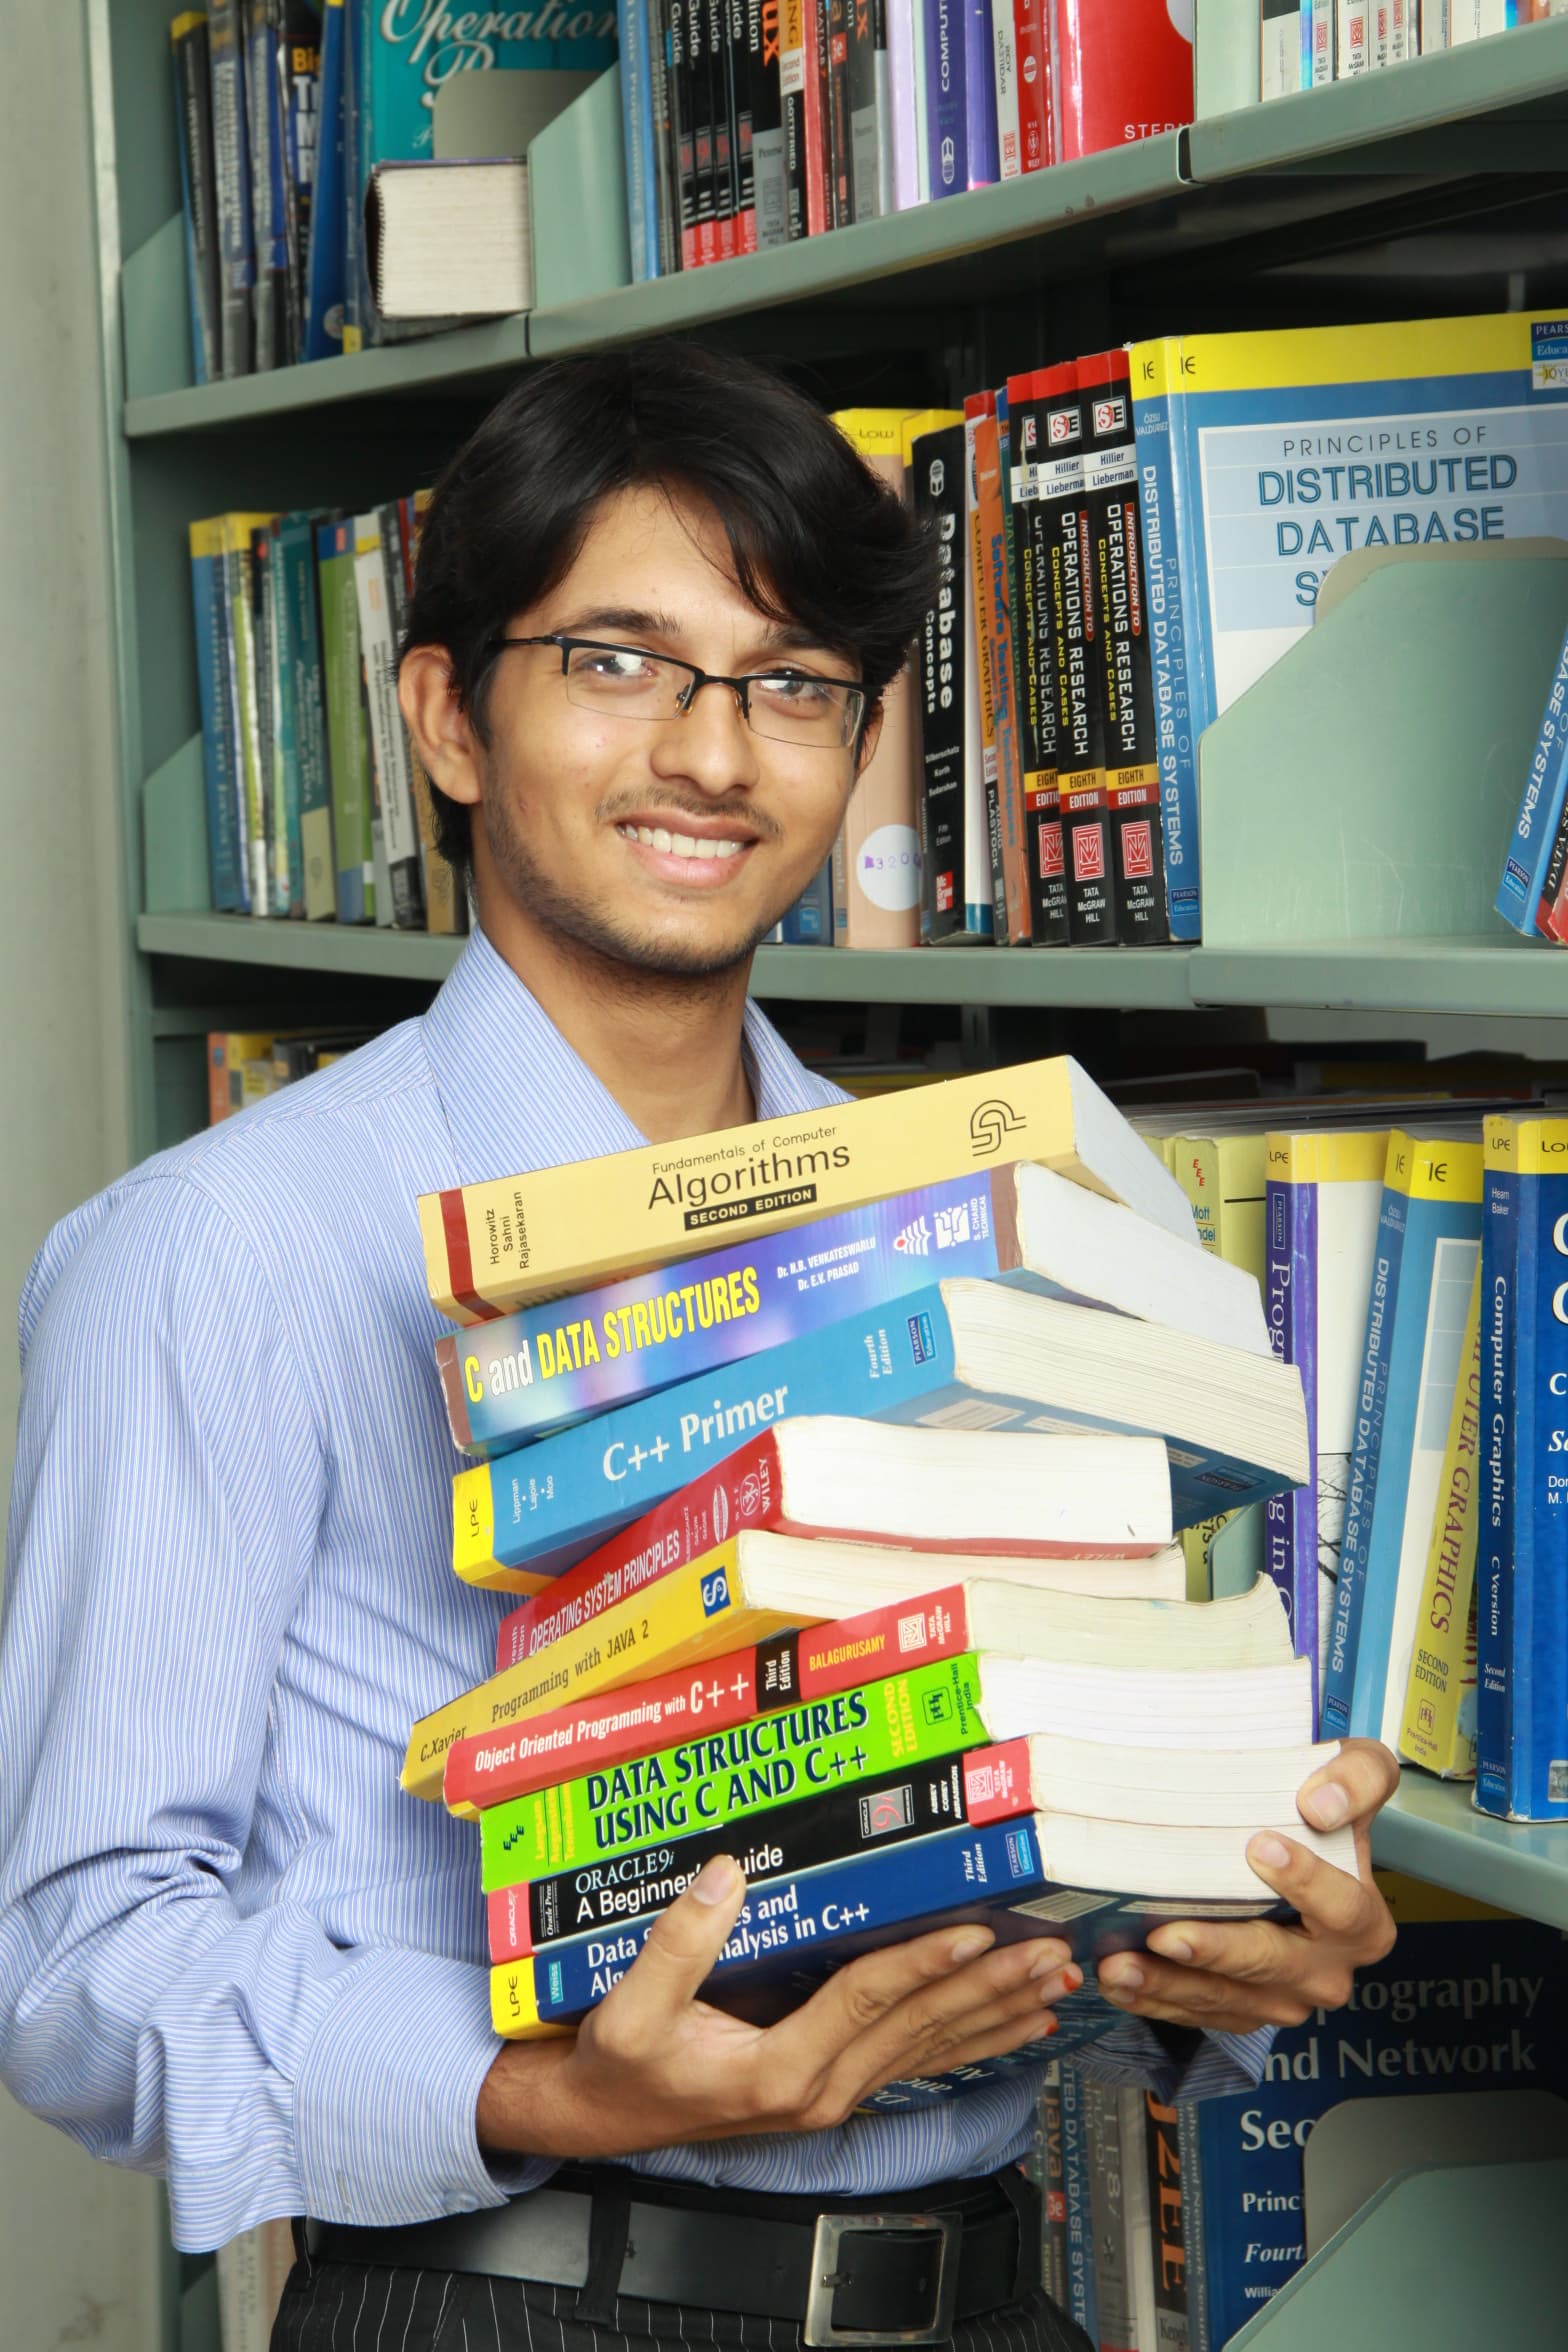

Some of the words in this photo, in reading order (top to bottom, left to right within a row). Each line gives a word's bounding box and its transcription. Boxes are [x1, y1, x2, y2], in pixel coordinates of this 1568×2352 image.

[1100, 451, 1125, 466] Hillier
[1282, 428, 1438, 457] PRINCIPLES
[1453, 425, 1488, 445] OF
[1055, 461, 1080, 475] Hillier
[1092, 468, 1134, 487] Lieberman
[1257, 453, 1518, 506] DISTRIBUTED
[1142, 464, 1166, 614] DISTRIBUTED
[1276, 506, 1506, 556] DATABASE
[1061, 511, 1082, 640] OPERATIONS
[1098, 538, 1110, 624] CONCEPTS
[1106, 503, 1129, 634] OPERATIONS
[1125, 510, 1140, 606] INTRODUCTION
[1051, 547, 1064, 630] CONCEPTS
[925, 610, 936, 715] Concepts
[1023, 549, 1035, 631] CONCEPTS
[1029, 674, 1038, 726] CASES
[1056, 636, 1066, 669] AND
[1104, 629, 1113, 662] AND
[1153, 620, 1176, 749] DATABASE
[1165, 558, 1188, 719] PRINCIPLES
[1177, 735, 1191, 769] OF
[1059, 674, 1069, 727] CASES
[1069, 646, 1089, 756] RESEARCH
[1107, 668, 1117, 721] CASES
[1115, 640, 1137, 752] RESEARCH
[1070, 773, 1096, 789] EIGHTH
[1070, 791, 1099, 809] EDITION
[1117, 768, 1144, 785] EIGHTH
[1117, 788, 1147, 806] EDITION
[1518, 719, 1556, 840] SYSTEMS
[1162, 754, 1184, 866] SYSTEMS
[1077, 899, 1106, 912] McGRAW
[1083, 886, 1100, 898] TATA
[1132, 884, 1149, 896] TATA
[1085, 913, 1100, 923] HILL
[1134, 911, 1149, 922] HILL
[651, 1144, 746, 1174] Fundamentals
[752, 1139, 766, 1154] of
[771, 1125, 838, 1150] Computer
[1269, 1150, 1289, 1164] LPE
[1491, 1138, 1511, 1151] LPE
[647, 1144, 851, 1210] Algorithms
[518, 1191, 530, 1269] Rajasekaran
[689, 1203, 749, 1226] SECOND
[755, 1188, 813, 1211] EDITION
[970, 1197, 980, 1229] CHAND
[1491, 1202, 1509, 1216] Baker
[488, 1207, 500, 1265] Horowitz
[502, 1215, 514, 1253] Sahni
[777, 1265, 789, 1279] Dr.
[807, 1236, 877, 1268] VENKATESWARLU
[798, 1279, 810, 1292] Dr.
[810, 1273, 826, 1288] E.V.
[826, 1261, 860, 1284] PRASAD
[463, 1356, 484, 1403] C
[488, 1340, 534, 1396] and
[537, 1314, 595, 1381] DATA
[604, 1265, 761, 1360] STRUCTURES
[864, 1334, 880, 1379] Fourth
[878, 1328, 893, 1376] Edition
[908, 1318, 923, 1363] PEARSON
[1361, 1256, 1390, 1413] DISTRIBUTED
[1489, 1275, 1507, 1405] Computer
[602, 1435, 670, 1482] C++
[680, 1385, 789, 1452] Primer
[1361, 1361, 1388, 1530] PRINCIPLES
[758, 1457, 771, 1515] WILEY
[1347, 1418, 1372, 1552] DATABASE
[1488, 1412, 1506, 1528] Graphics
[470, 1497, 480, 1538] LPE
[512, 1478, 522, 1524] Lippman
[1272, 1535, 1290, 1573] in
[1356, 1544, 1369, 1582] OF
[1429, 1465, 1471, 1634] GRAPHICS
[528, 1595, 583, 1658] OPERATING
[584, 1572, 622, 1620] SYSTEM
[623, 1528, 681, 1596] PRINCIPLES
[1331, 1555, 1355, 1674] SYSTEMS
[1490, 1577, 1501, 1637] Version
[765, 1659, 777, 1692] Third
[779, 1649, 791, 1693] Edition
[808, 1633, 886, 1673] BALAGURUSAMY
[1417, 1648, 1450, 1677] SECOND
[1483, 1663, 1506, 1679] Second
[420, 1724, 468, 1763] C.Xavier
[491, 1667, 570, 1724] Programming
[574, 1646, 602, 1677] with
[606, 1630, 637, 1659] JAVA
[641, 1619, 650, 1639] 2
[951, 1663, 968, 1736] Prentice-Hall
[963, 1681, 974, 1711] India
[1414, 1664, 1448, 1693] EDITION
[1484, 1677, 1506, 1693] Edition
[474, 1741, 516, 1773] Object
[519, 1725, 573, 1760] Oriented
[576, 1700, 663, 1746] Programming
[664, 1695, 686, 1718] with
[690, 1672, 750, 1715] C++
[884, 1681, 902, 1758] SECOND
[898, 1678, 918, 1752] EDITION
[587, 1758, 668, 1812] DATA
[673, 1690, 869, 1793] STRUCTURES
[594, 1791, 689, 1849] USING
[696, 1785, 720, 1818] C
[727, 1757, 797, 1812] AND
[804, 1744, 869, 1785] C++
[962, 1850, 975, 1882] Third
[976, 1843, 988, 1883] Edition
[576, 1896, 595, 1924] A
[587, 1937, 638, 1970] Data
[758, 1884, 798, 1921] and
[717, 1920, 790, 1961] nalysis
[794, 1915, 817, 1938] in
[820, 1902, 871, 1932] C++
[508, 1975, 521, 2017] LPE
[551, 1962, 561, 2000] Weiss
[1338, 2029, 1537, 2079] Network
[1064, 2118, 1083, 2246] DATABASE
[1145, 2088, 1187, 2292] J2EE
